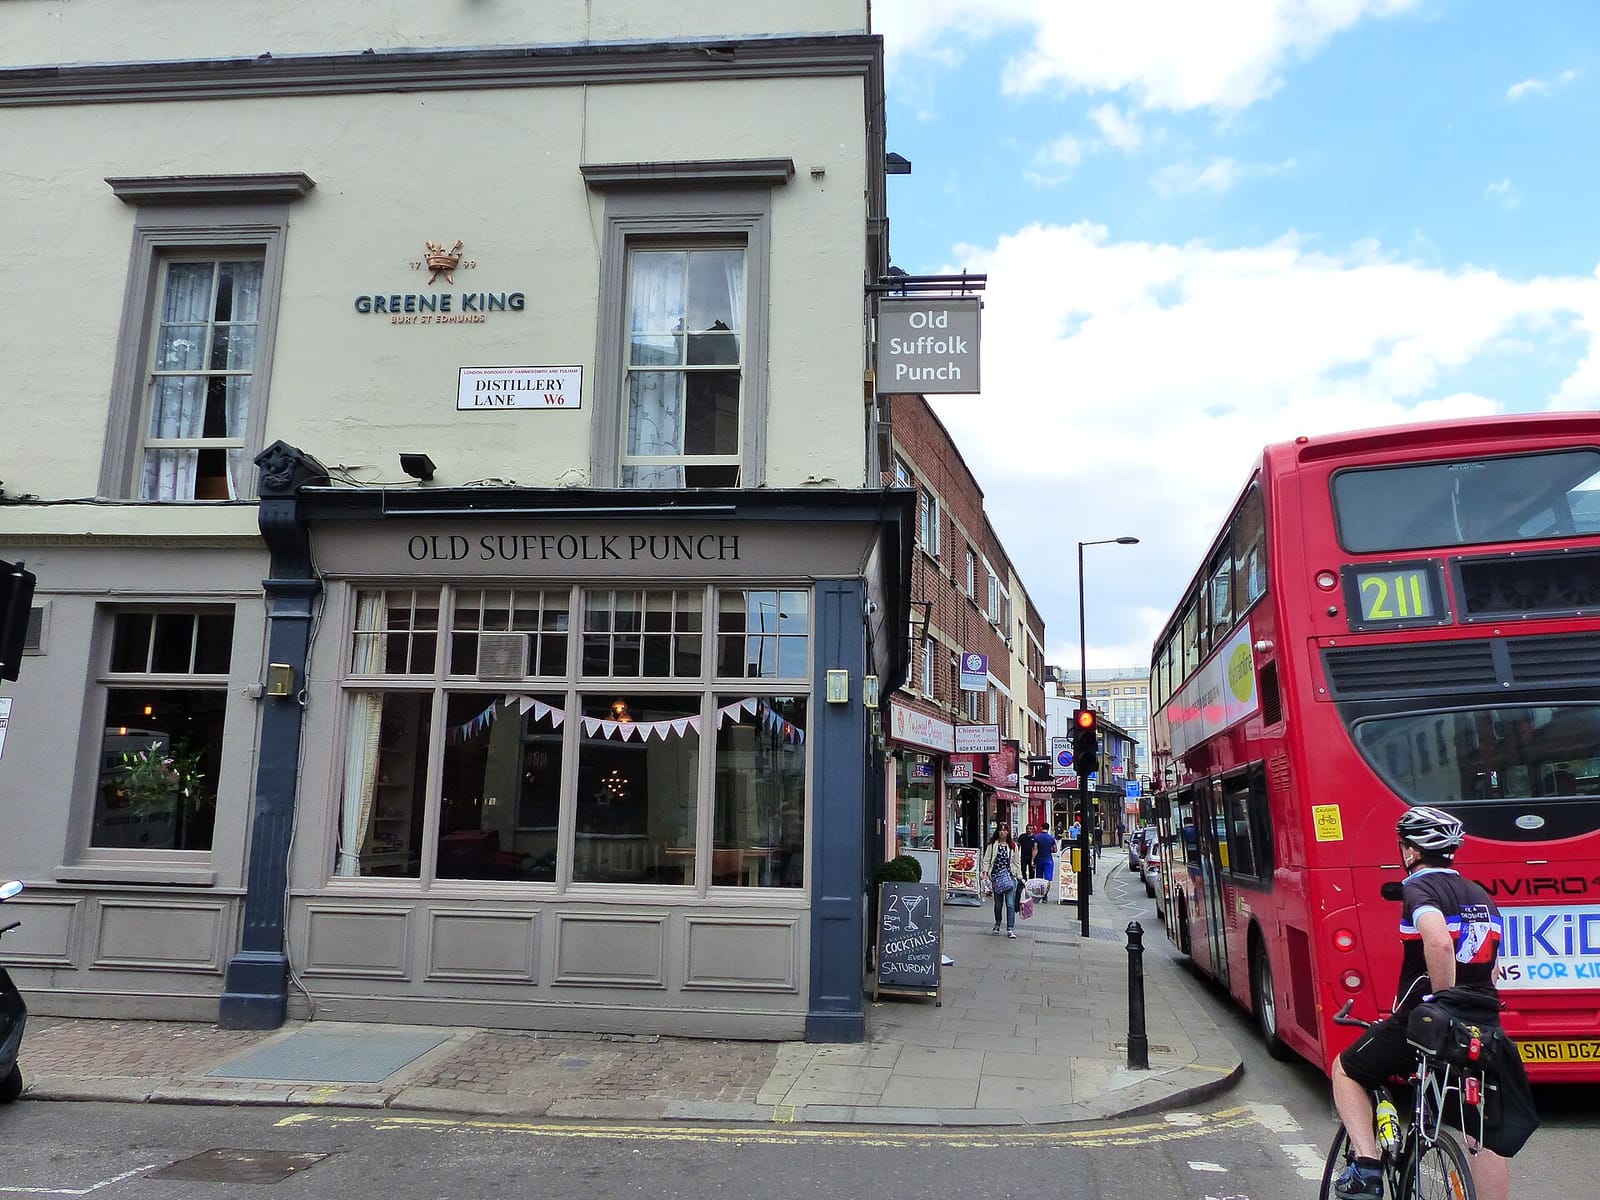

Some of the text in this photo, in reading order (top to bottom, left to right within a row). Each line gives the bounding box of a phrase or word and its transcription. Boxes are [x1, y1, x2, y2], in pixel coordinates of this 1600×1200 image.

[354, 291, 526, 314] GREENE KING
[390, 314, 486, 324] BURY ST EDMUNDS
[909, 310, 948, 329] Old
[889, 335, 968, 355] Suffolk
[895, 361, 961, 381] Punch
[476, 379, 565, 391] DISTILLERY
[474, 393, 565, 406] LANE W6
[408, 534, 741, 561] OLD SUFFOLK PUNCH
[1361, 574, 1423, 619] 211
[1473, 876, 1588, 896] NVIRO
[888, 894, 898, 913] 2
[885, 930, 937, 954] COCKTAILS
[1526, 962, 1569, 980] FOR
[1523, 1042, 1600, 1059] SN61 DGZ
